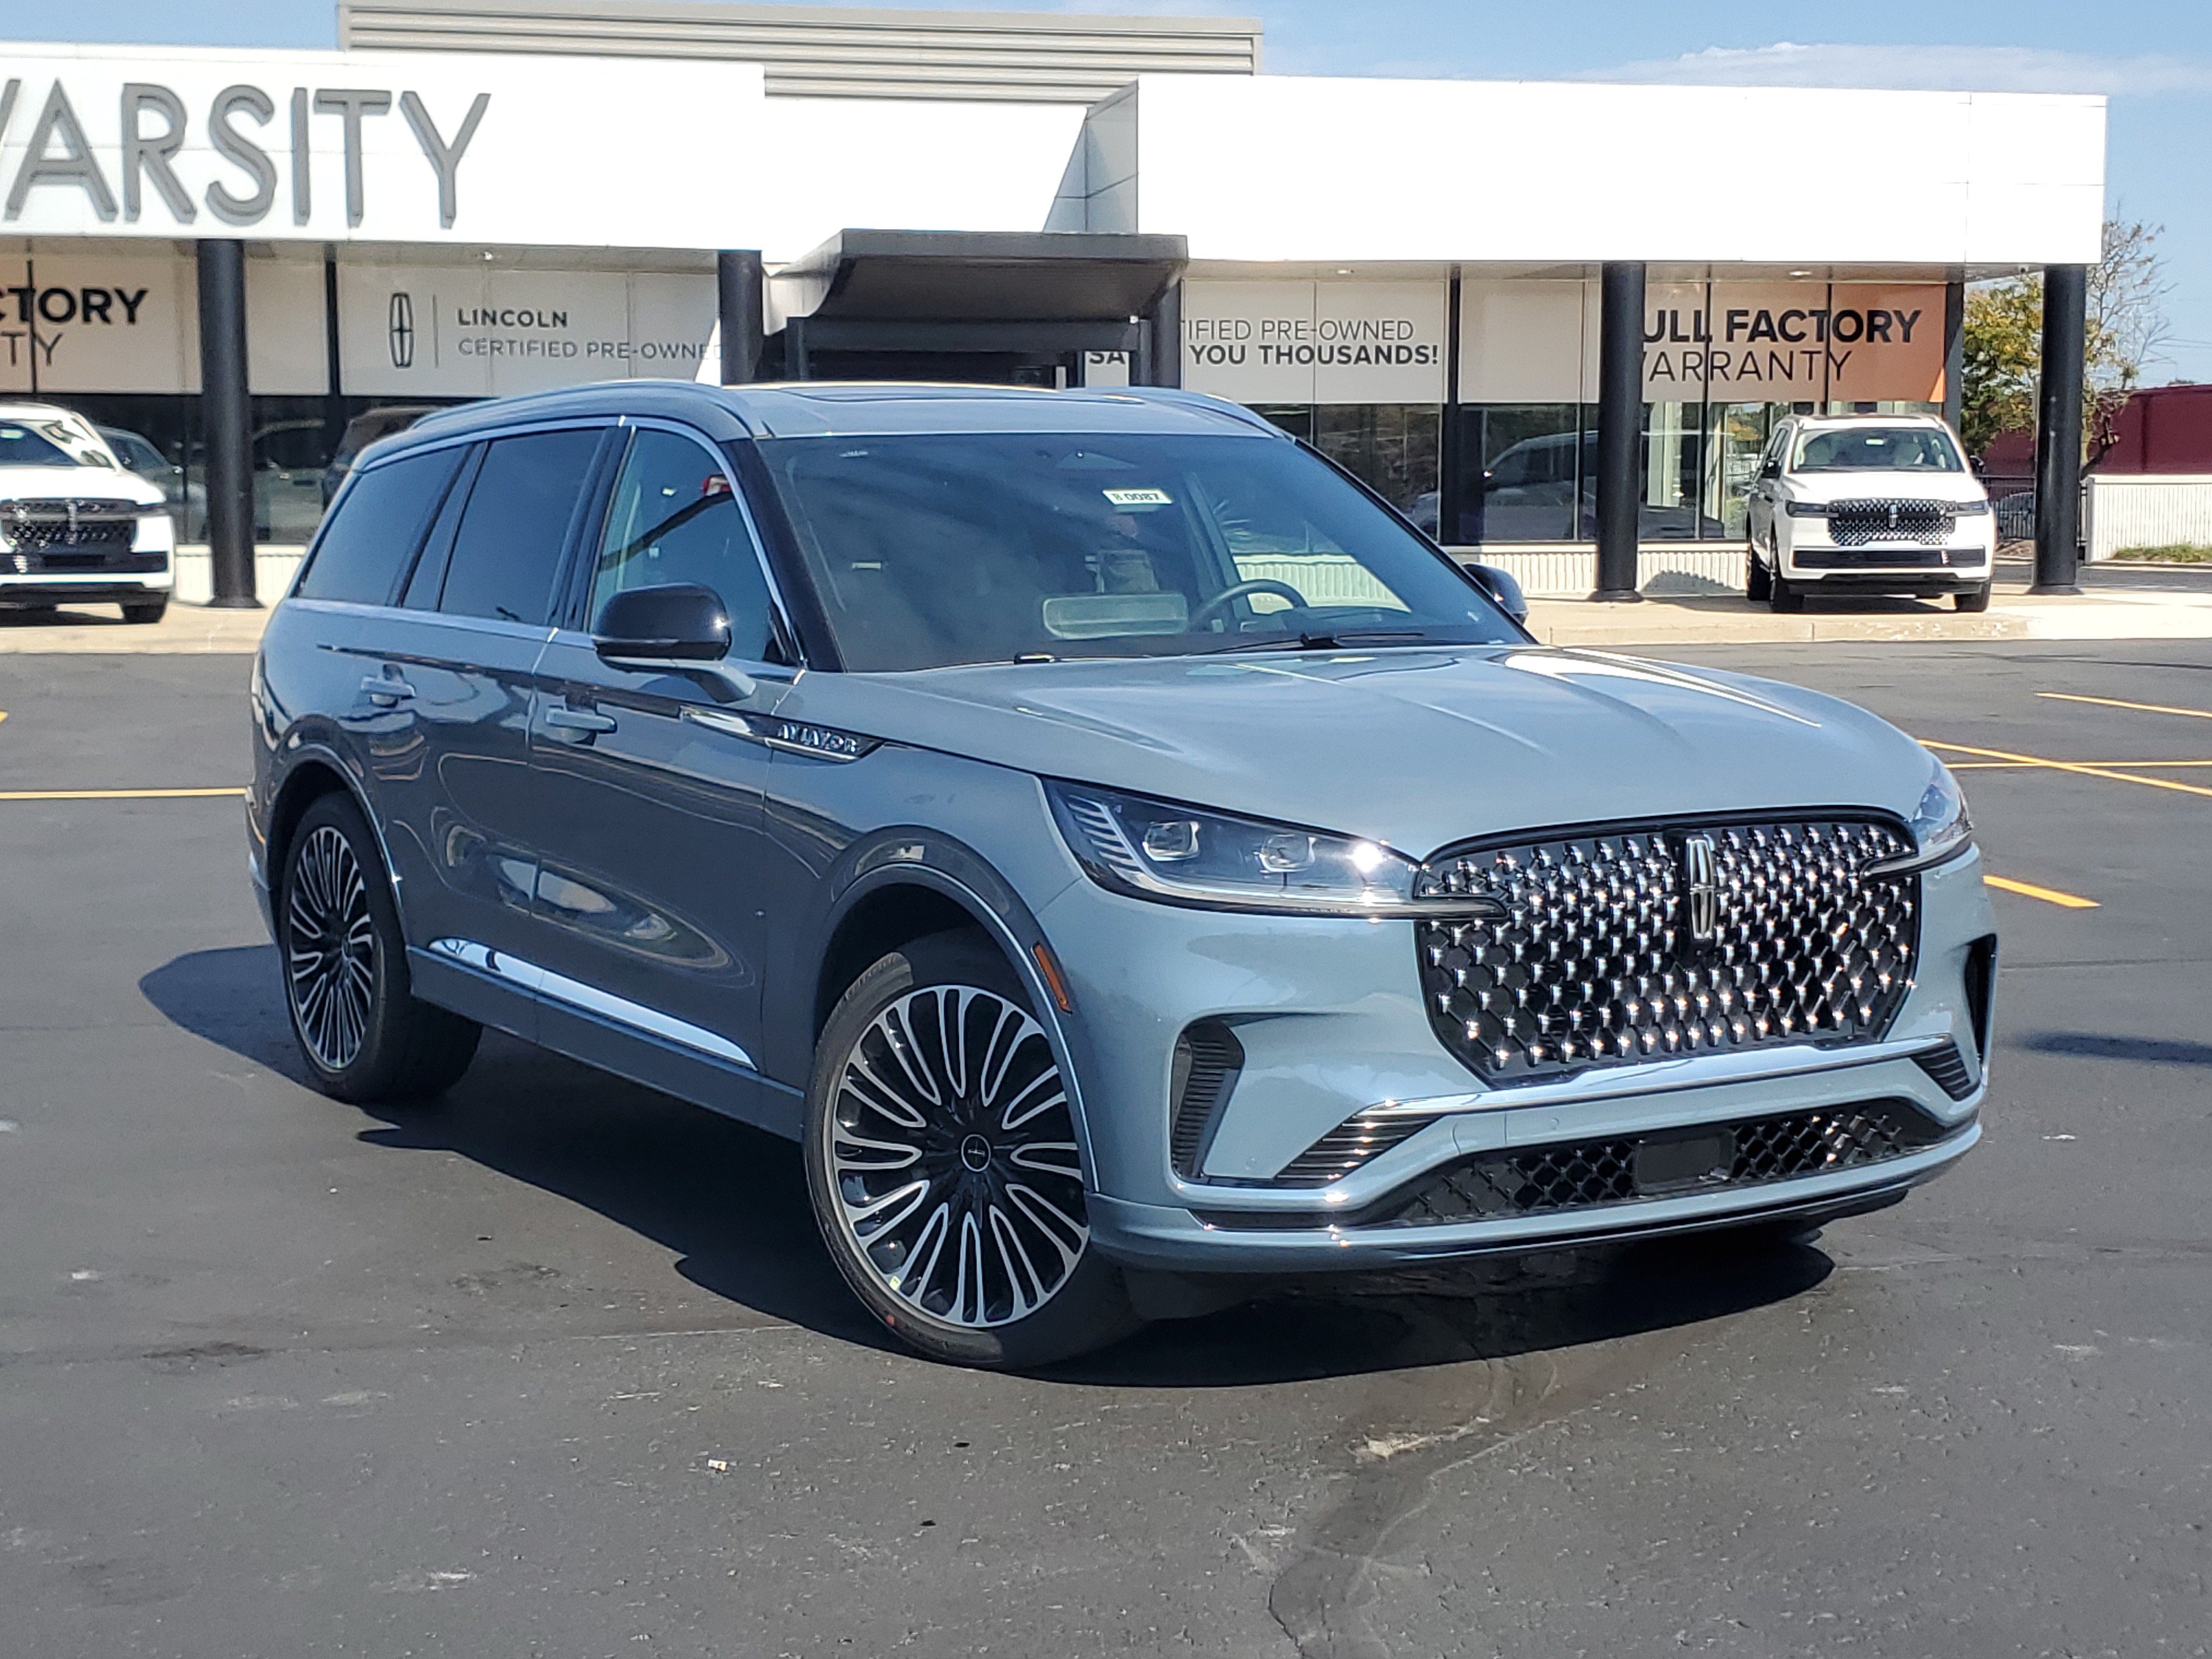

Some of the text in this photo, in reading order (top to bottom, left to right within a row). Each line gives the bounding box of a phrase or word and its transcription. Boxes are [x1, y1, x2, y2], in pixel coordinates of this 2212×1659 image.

[458, 307, 568, 328] LINCOLN
[1726, 309, 1923, 343] FACTORY
[1180, 319, 1414, 341] IFIED PRE-OWNED
[458, 337, 578, 358] CERTIFIED
[1188, 344, 1246, 365] YOU
[1257, 344, 1439, 366] THOUSANDS!
[1643, 350, 1853, 382] ARRANTY
